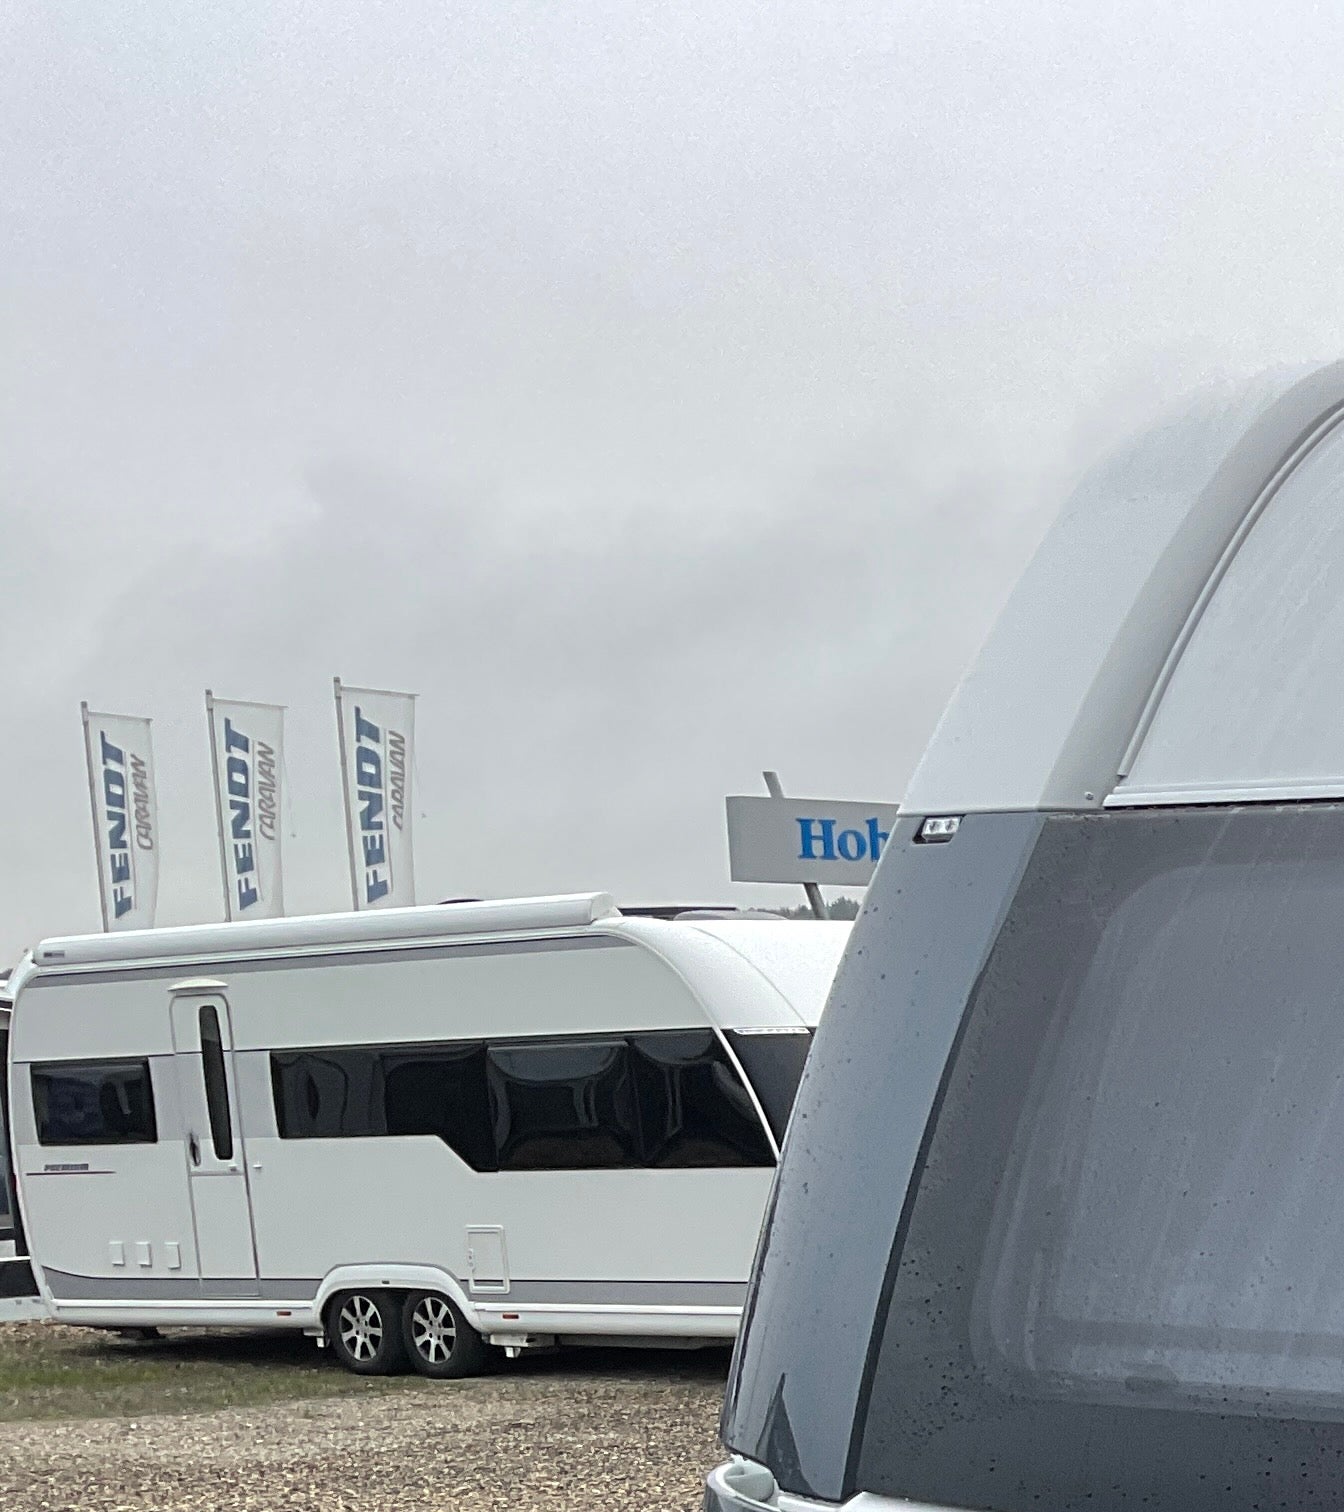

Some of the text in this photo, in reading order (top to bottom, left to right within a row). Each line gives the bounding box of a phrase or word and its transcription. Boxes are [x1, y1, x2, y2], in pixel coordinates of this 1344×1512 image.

[100, 730, 132, 919] FENDT
[130, 754, 153, 850] CARAVAN
[224, 717, 258, 911] FENDT
[257, 741, 276, 841] CARAVAN
[355, 705, 389, 903] FENDT
[795, 817, 890, 863] Hob
